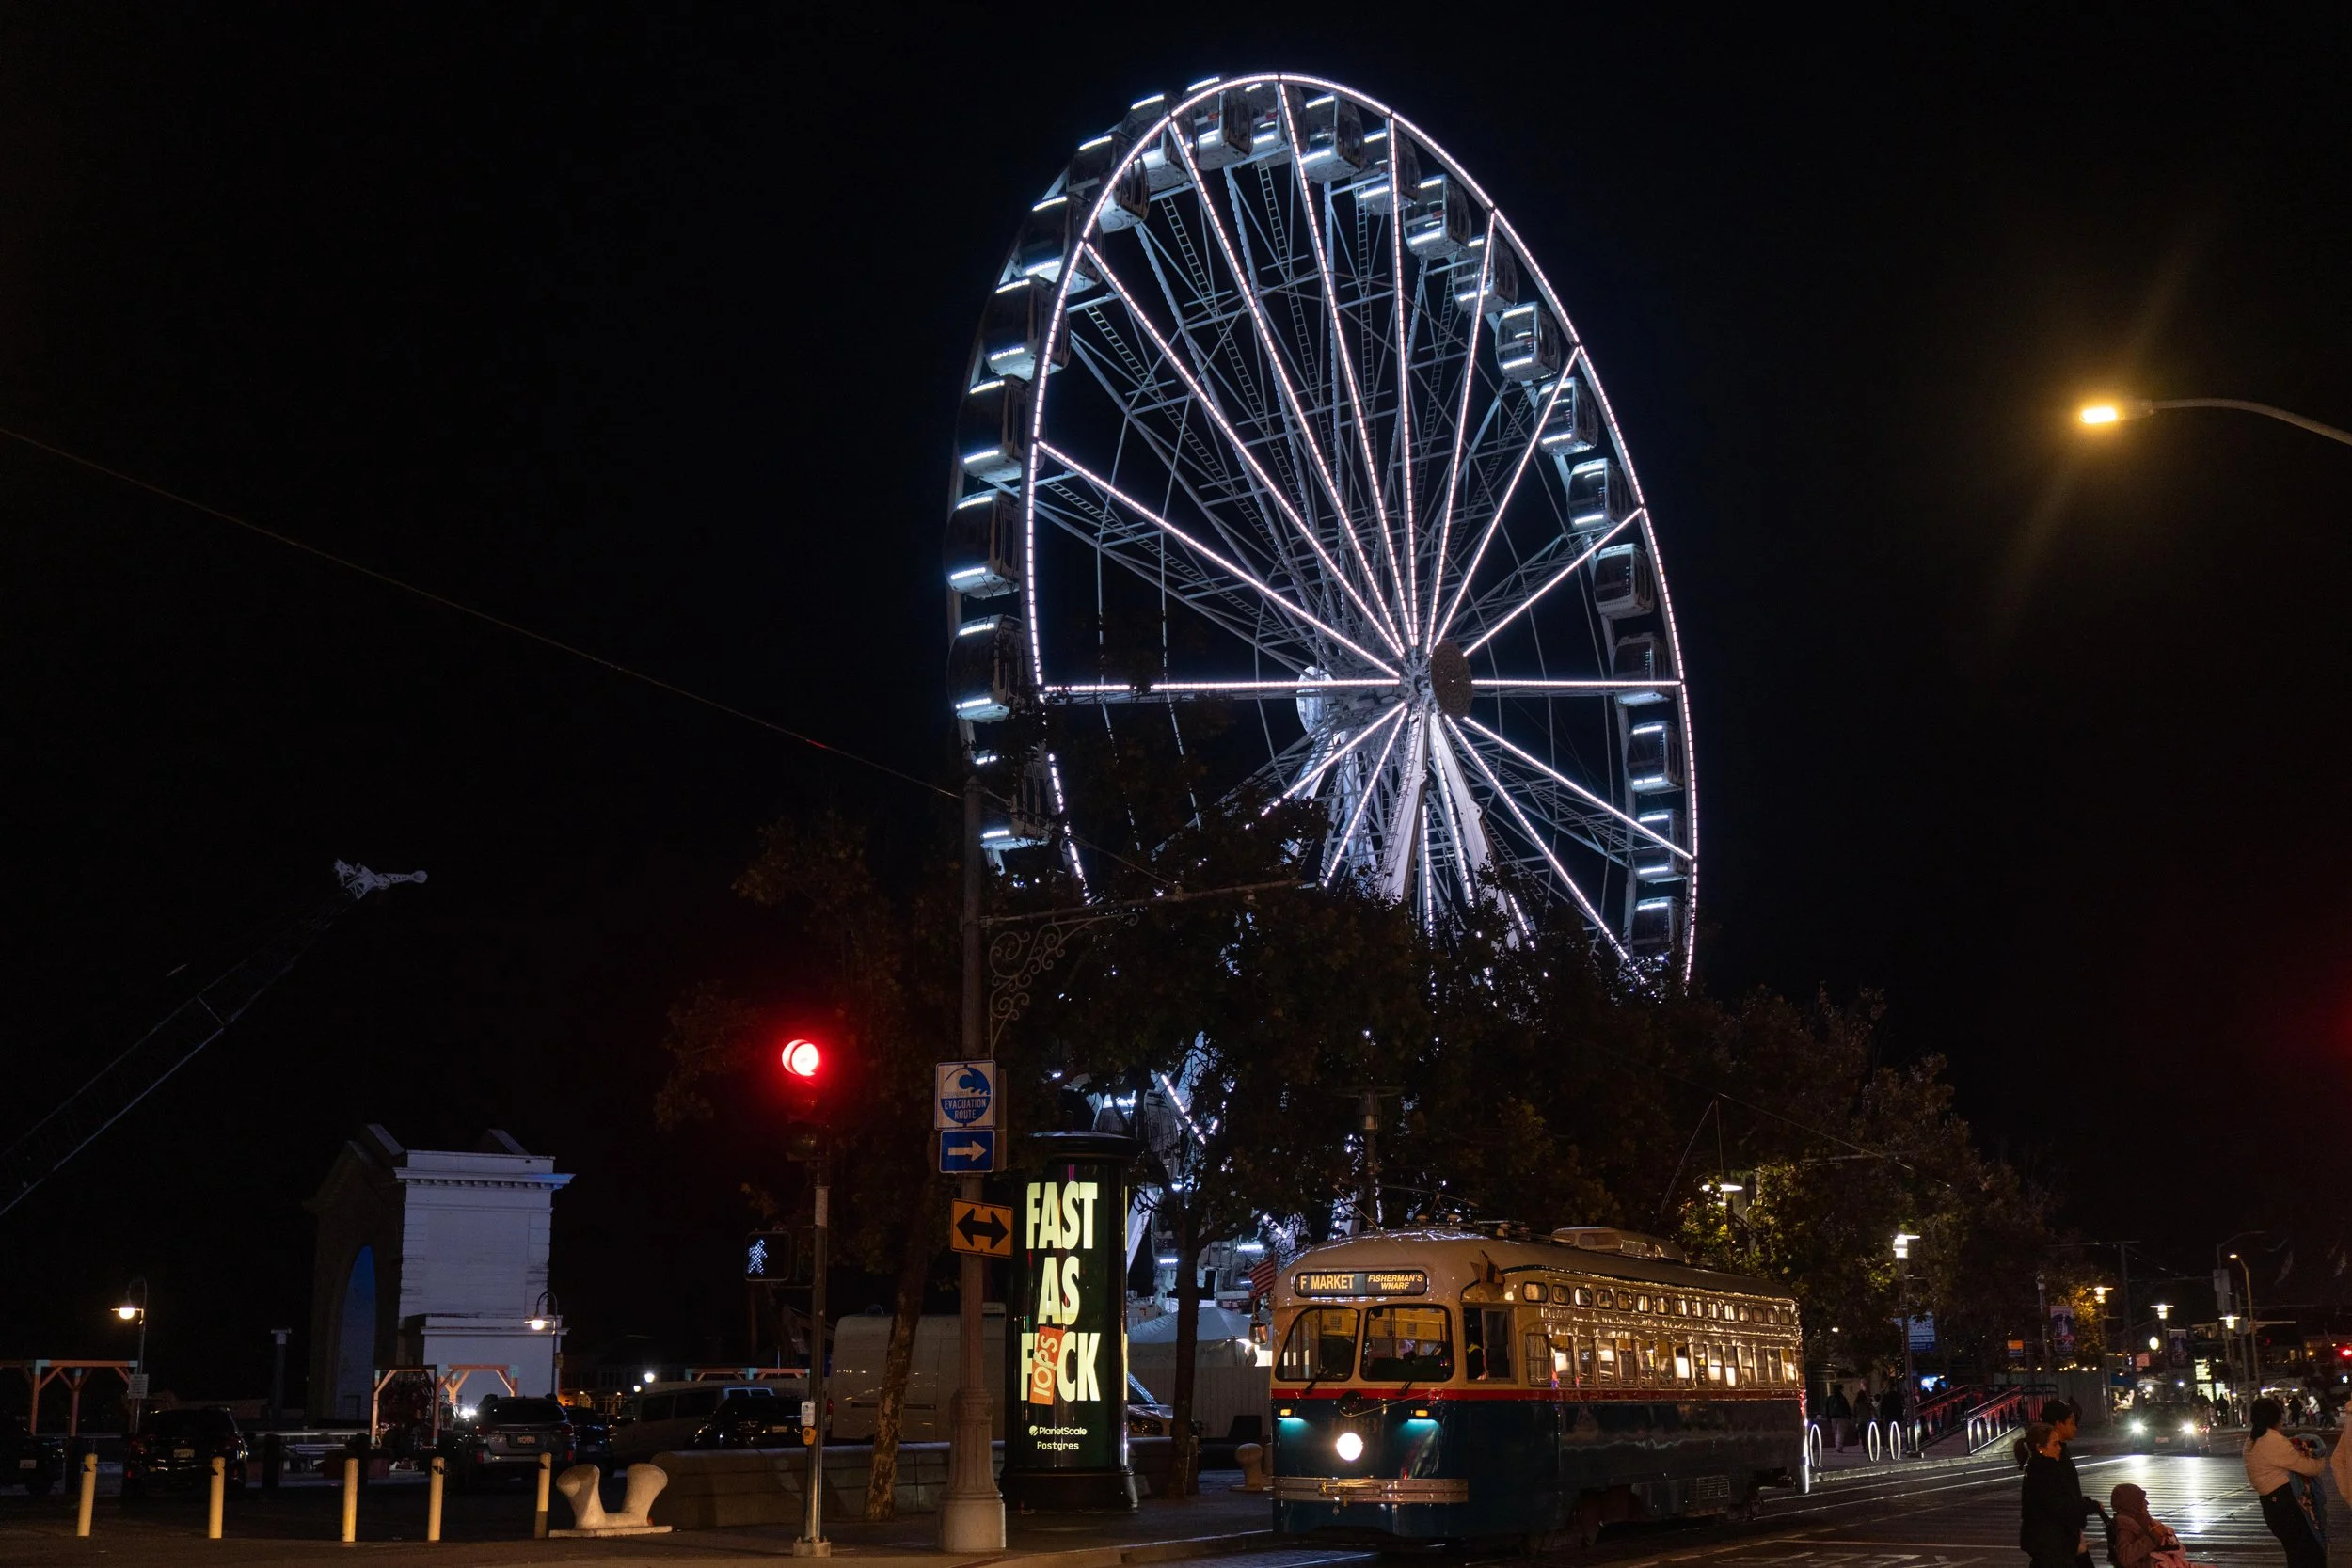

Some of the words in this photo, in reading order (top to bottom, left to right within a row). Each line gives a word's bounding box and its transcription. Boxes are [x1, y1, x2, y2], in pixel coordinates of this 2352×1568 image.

[945, 1099, 986, 1110] EVACUATION
[955, 1110, 977, 1119] ROUTE
[1026, 1181, 1098, 1250] FAST
[1300, 1276, 1307, 1290] F
[1311, 1275, 1354, 1290] MARKET
[1368, 1275, 1422, 1283] FISHERMAN'S
[1038, 1256, 1080, 1325] AS
[1021, 1332, 1101, 1402] FCK
[1033, 1335, 1058, 1397] IOPS
[1039, 1427, 1087, 1435] PlanetScale
[1037, 1441, 1079, 1451] Postgres
